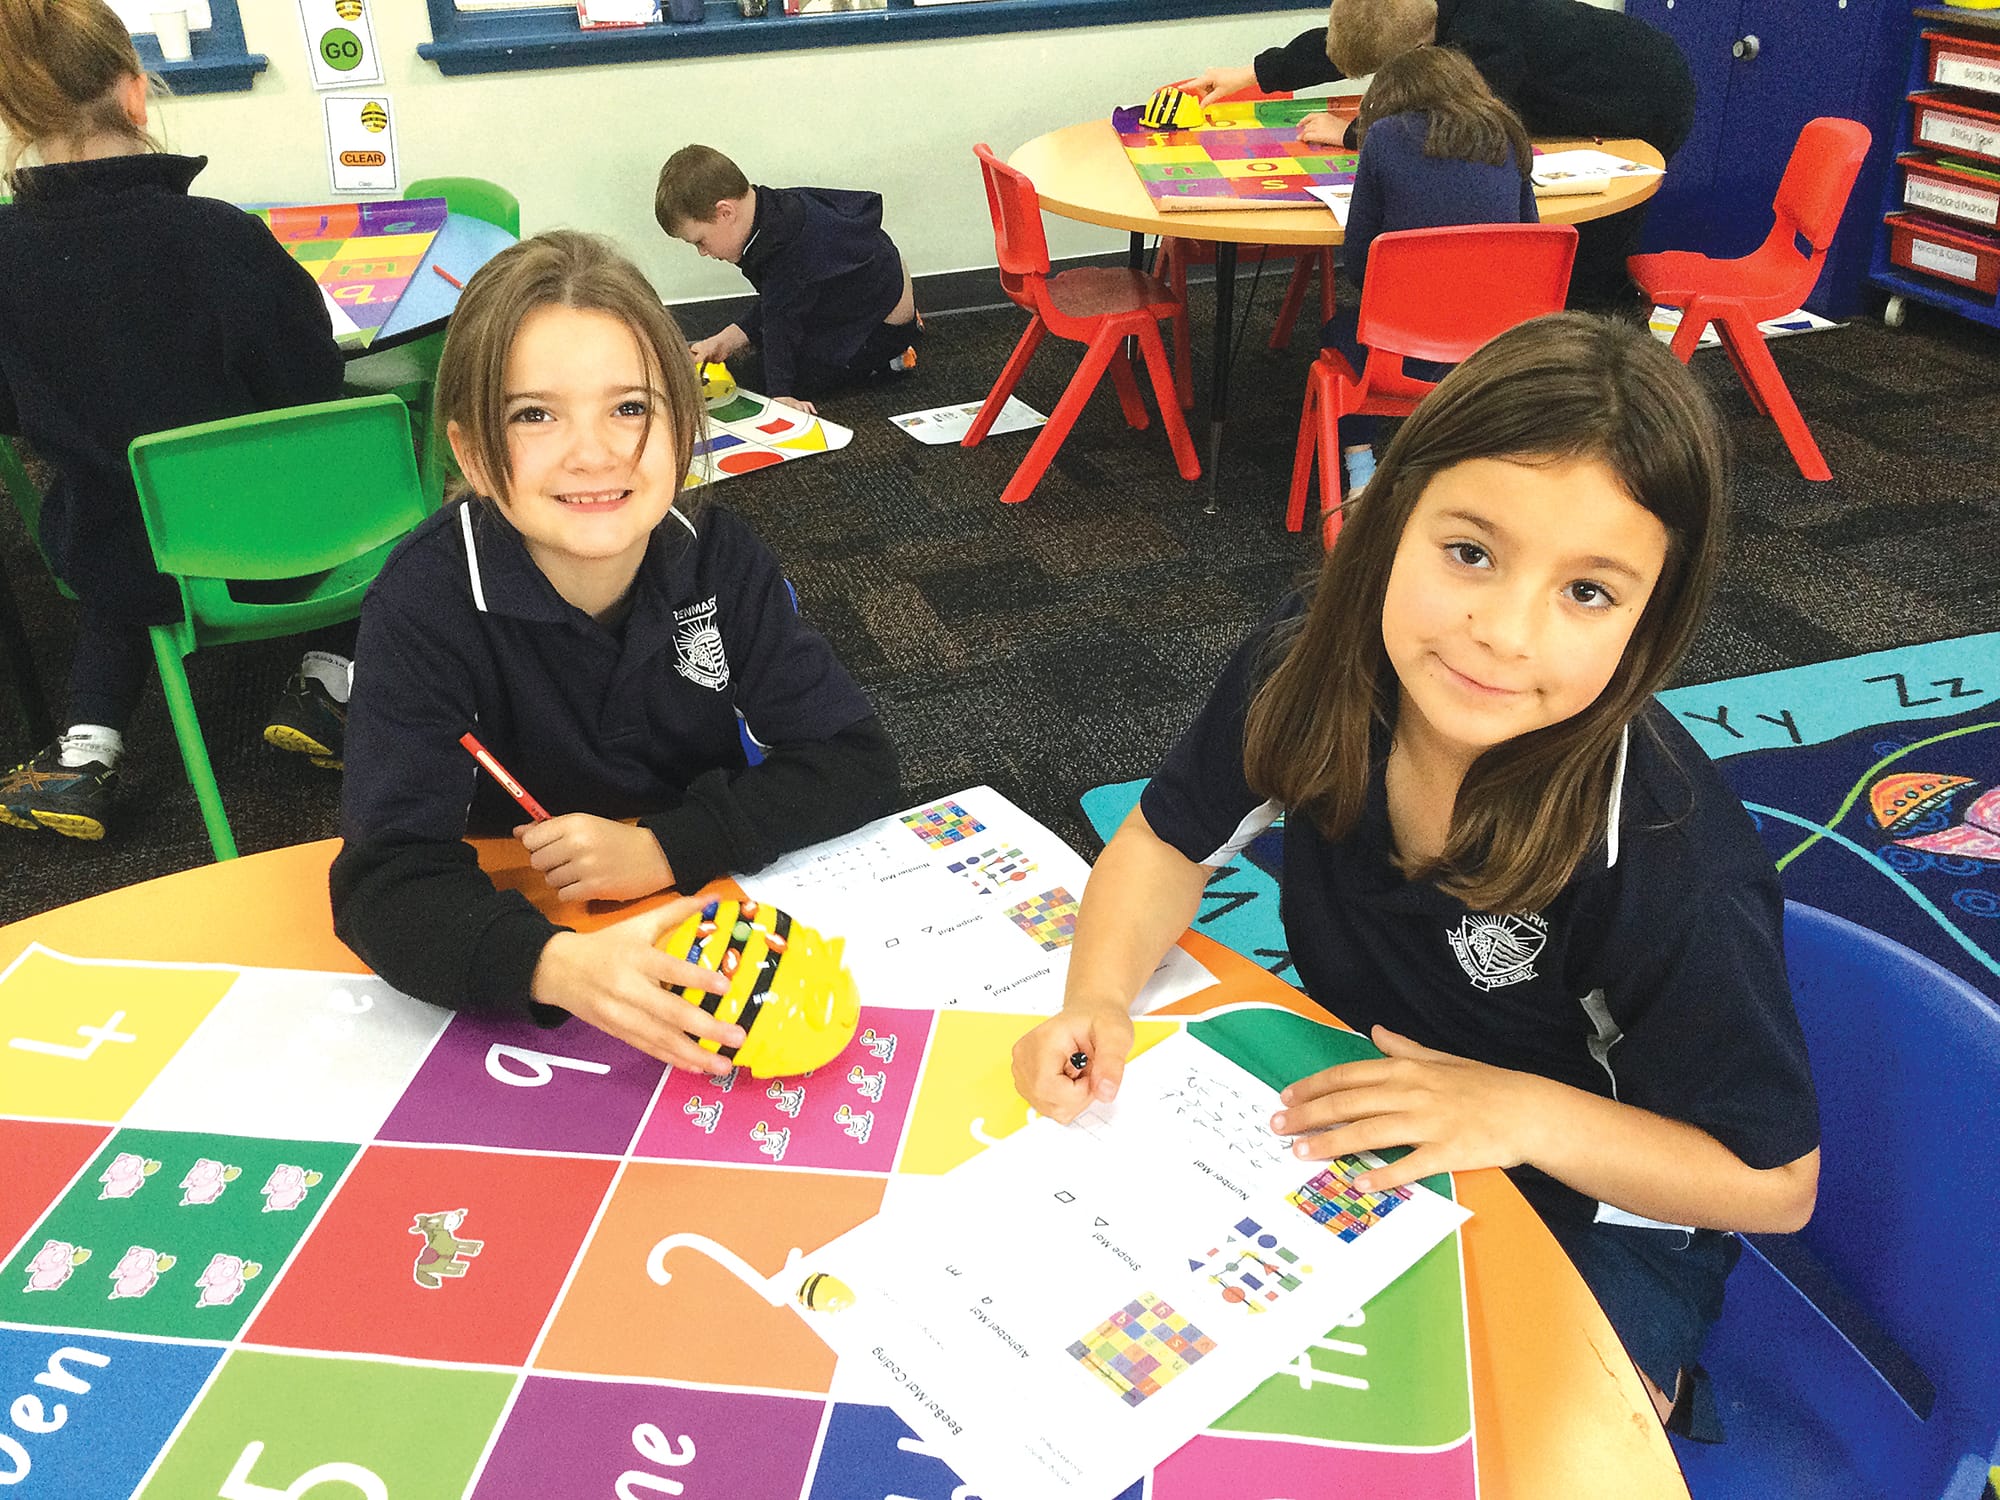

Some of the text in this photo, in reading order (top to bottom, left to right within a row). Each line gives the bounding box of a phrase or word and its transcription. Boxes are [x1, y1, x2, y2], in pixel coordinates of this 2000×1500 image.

[325, 41, 358, 60] GO
[344, 153, 382, 164] CLEAR
[992, 967, 1051, 997] Alphabet Mat
[8, 1010, 137, 1060] 4
[1192, 1159, 1250, 1201] Number Mat
[1091, 1232, 1142, 1272] Shape Mat
[969, 1306, 1030, 1358] Alphabet Mat
[871, 1345, 908, 1382] Coding
[904, 1380, 928, 1402] Mat
[923, 1400, 963, 1436] BeeBot
